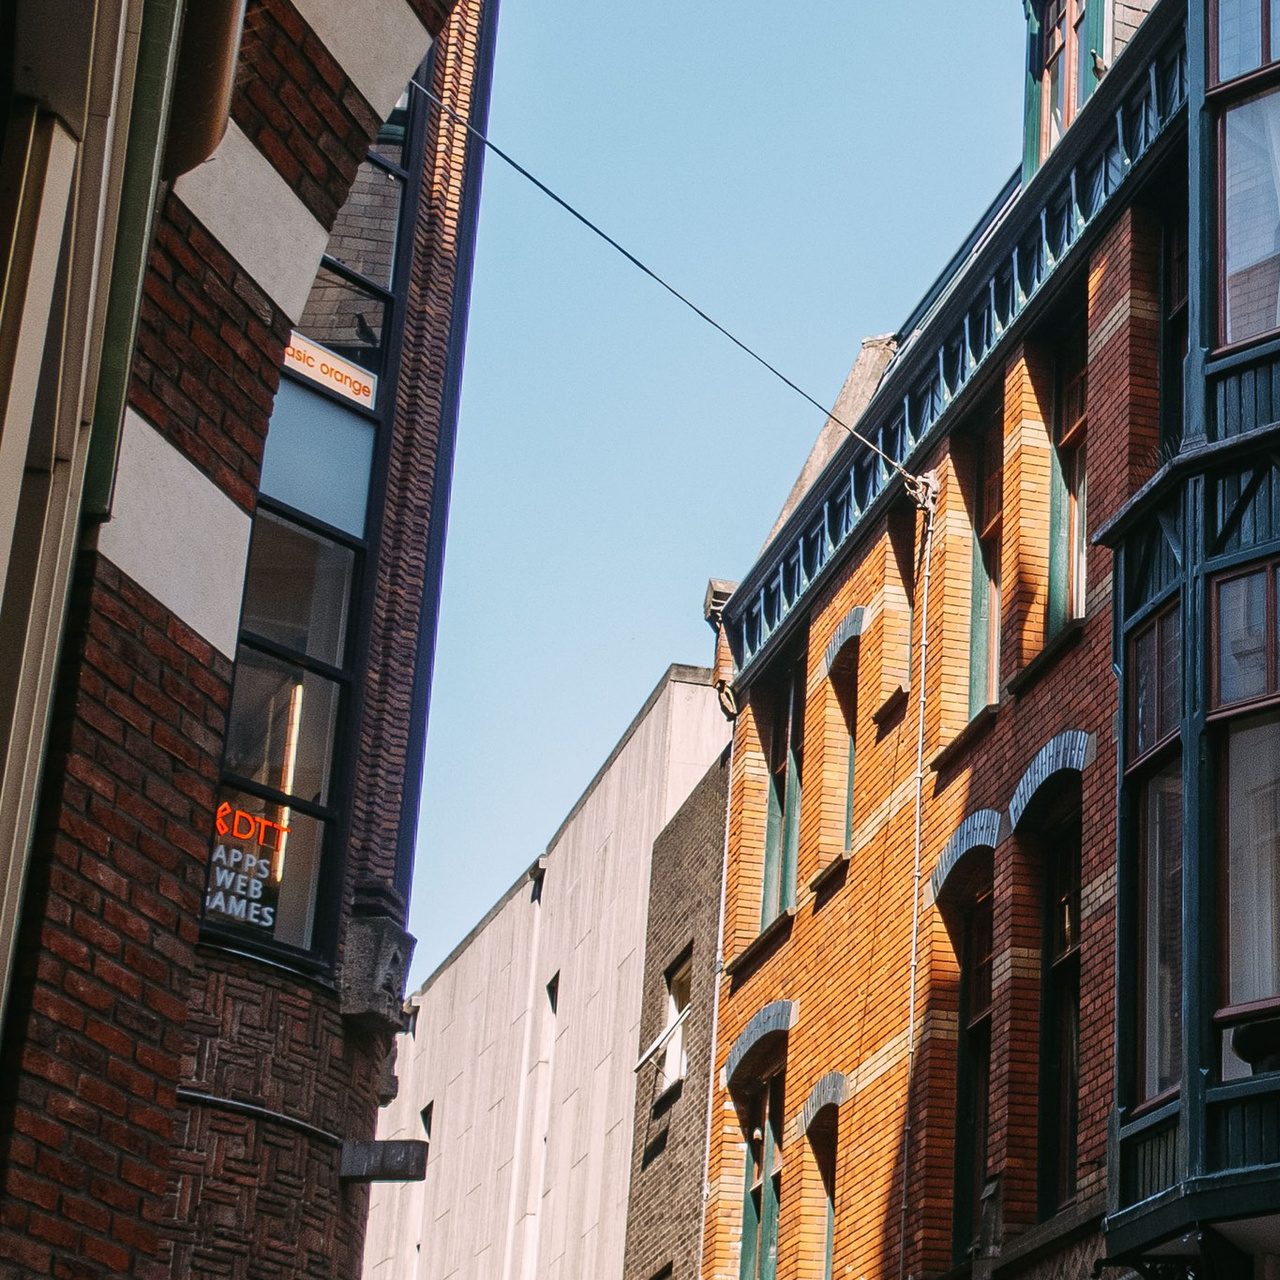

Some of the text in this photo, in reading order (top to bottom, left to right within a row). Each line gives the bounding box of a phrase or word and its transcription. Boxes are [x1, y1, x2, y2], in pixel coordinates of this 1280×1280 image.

[284, 346, 371, 397] asic orange
[212, 844, 270, 879] APPS
[215, 866, 263, 899] WEB
[206, 888, 274, 926] AMES
